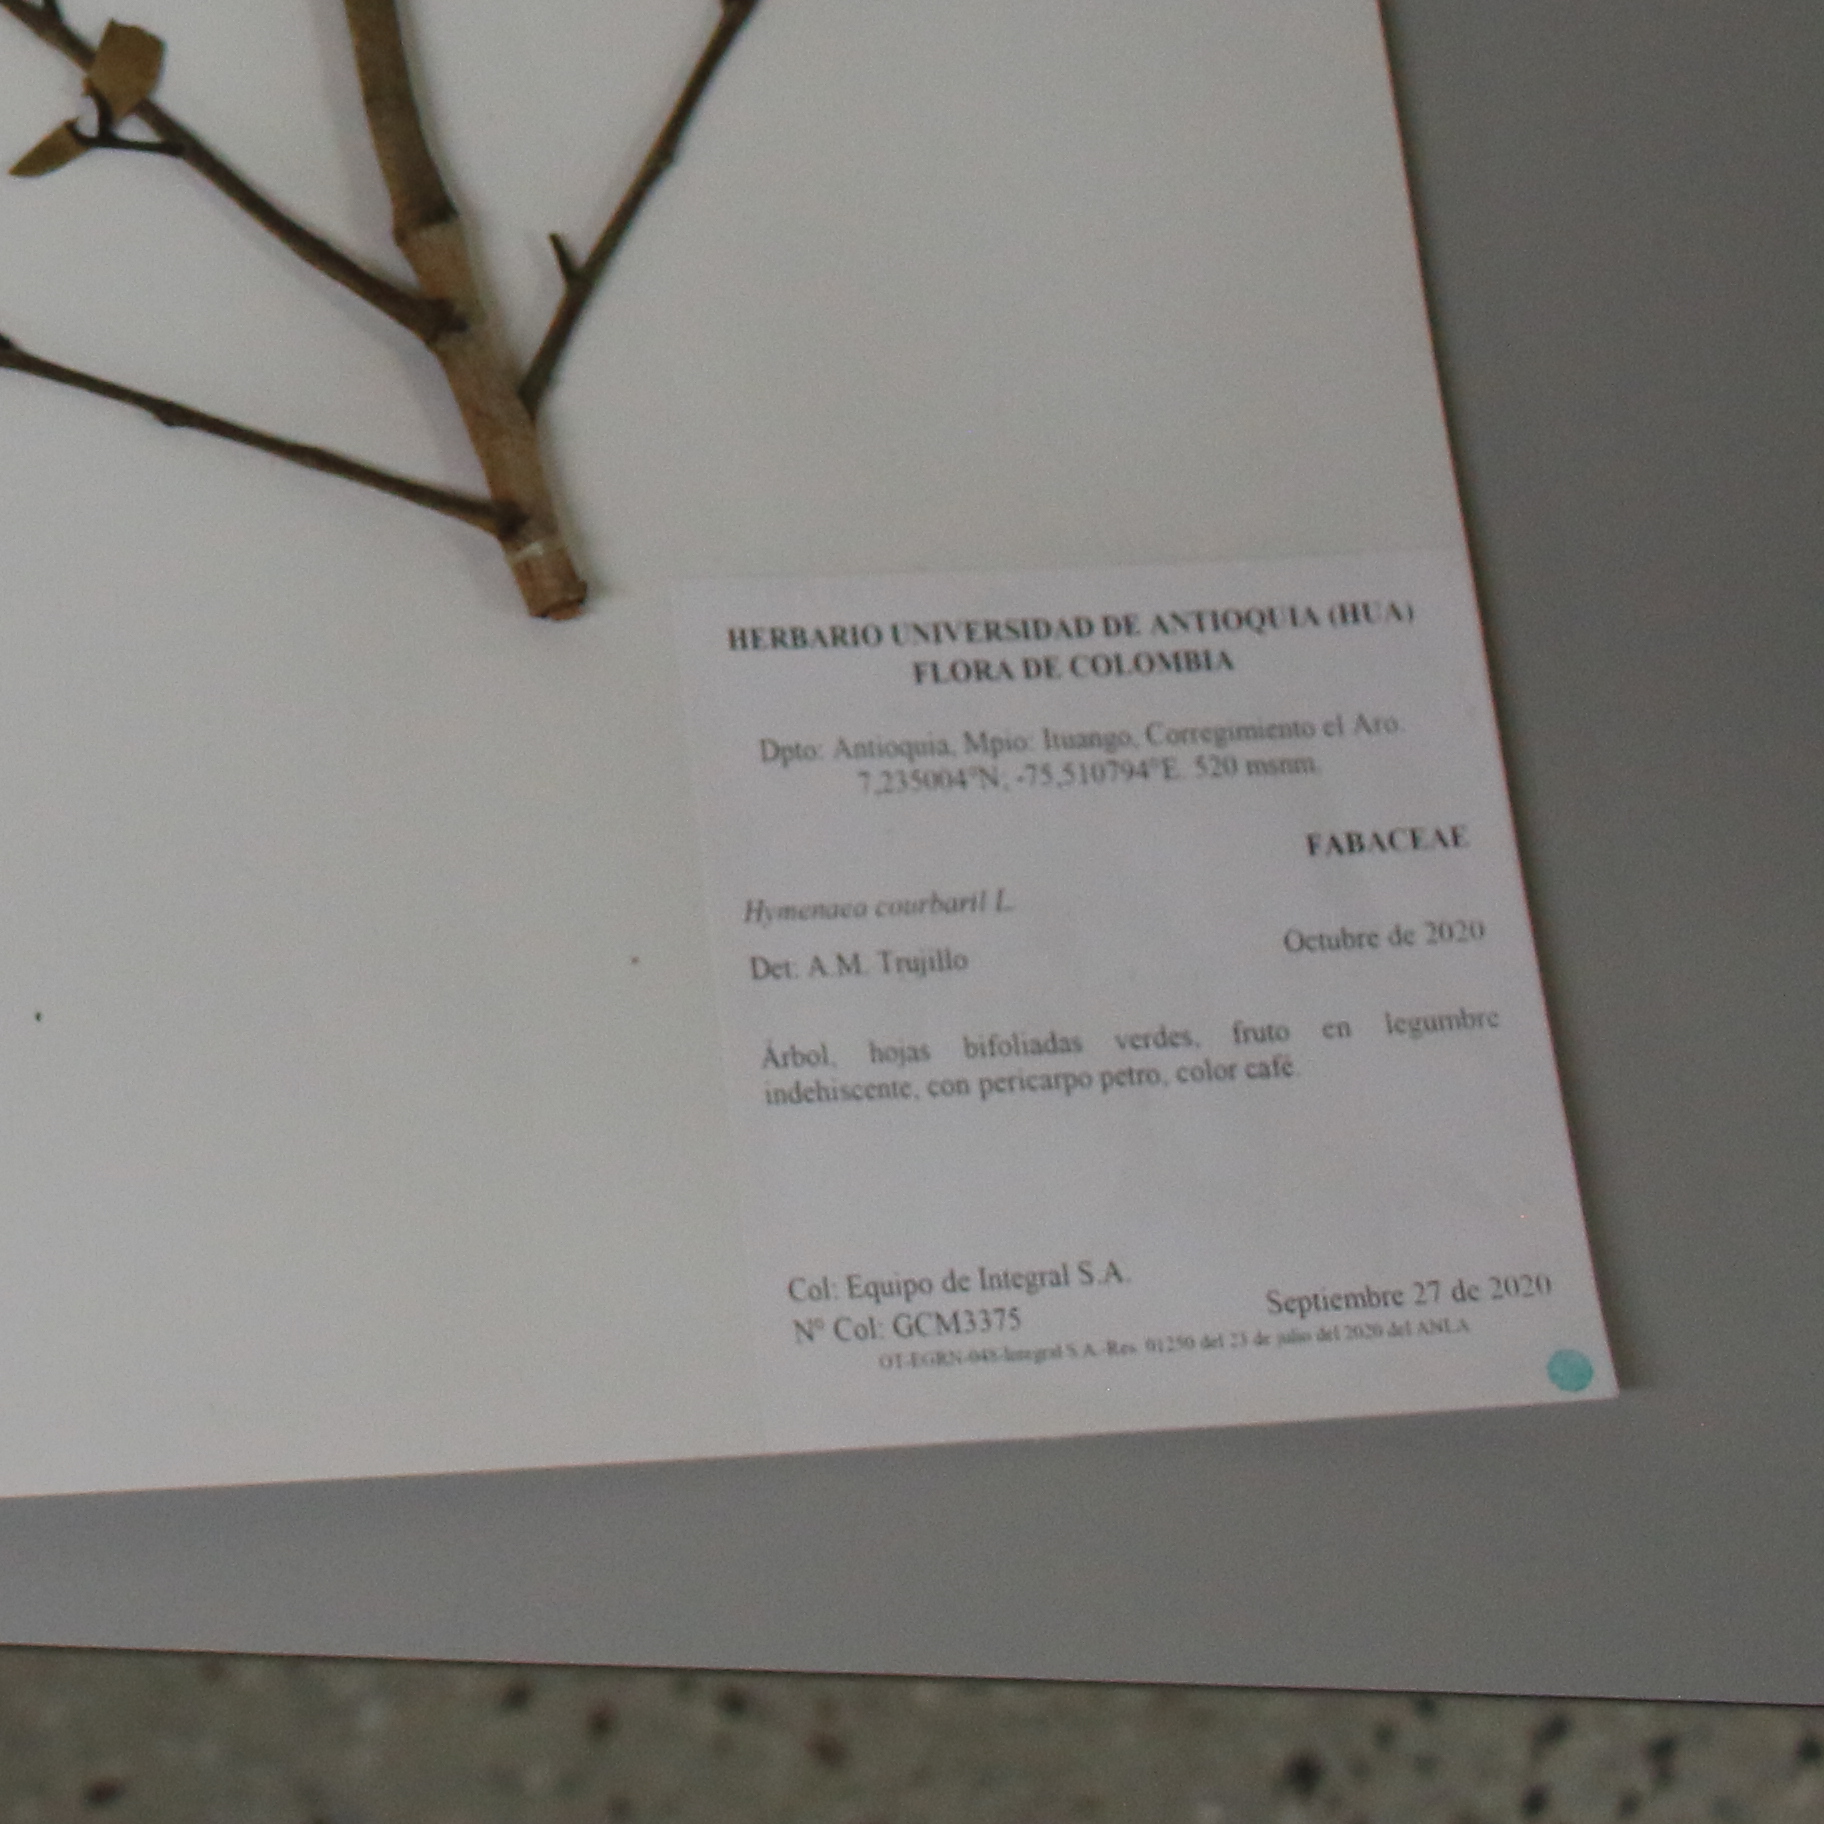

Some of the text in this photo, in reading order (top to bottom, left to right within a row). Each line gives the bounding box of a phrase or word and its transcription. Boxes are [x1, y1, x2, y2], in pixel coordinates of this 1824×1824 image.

[727, 601, 1415, 651] HERBARIO UNIVERSIDAD DE ANTIOQUIA (HUA)
[912, 648, 1235, 685] FLORA DE COLOMBIA
[1143, 720, 1317, 750] Corregimiento
[1321, 713, 1345, 739] el
[1194, 753, 1240, 779] 520
[1306, 825, 1469, 857] FABACEAE
[743, 898, 869, 929] Hymenaea
[874, 889, 988, 919] courbaril
[1282, 918, 1487, 954] Octubre de 2020
[877, 947, 970, 979] Trujillo
[867, 1040, 932, 1069] hojas
[962, 1029, 1085, 1060] bifoliadas
[1114, 1023, 1201, 1052] verdes,
[1231, 1019, 1291, 1046] fruto
[1321, 1020, 1353, 1040] en
[1384, 1006, 1500, 1041] legumbre
[764, 1078, 920, 1106] indehiscente,
[926, 1077, 972, 1099] con
[978, 1070, 1094, 1102] pericarpo
[1175, 1057, 1239, 1085] color
[786, 1260, 1129, 1306] Col: Equipo de Integral S.A.
[1265, 1273, 1553, 1321] Septiembre 27 de 2020
[832, 1315, 881, 1343] Col:
[891, 1305, 1022, 1340] GCM3375
